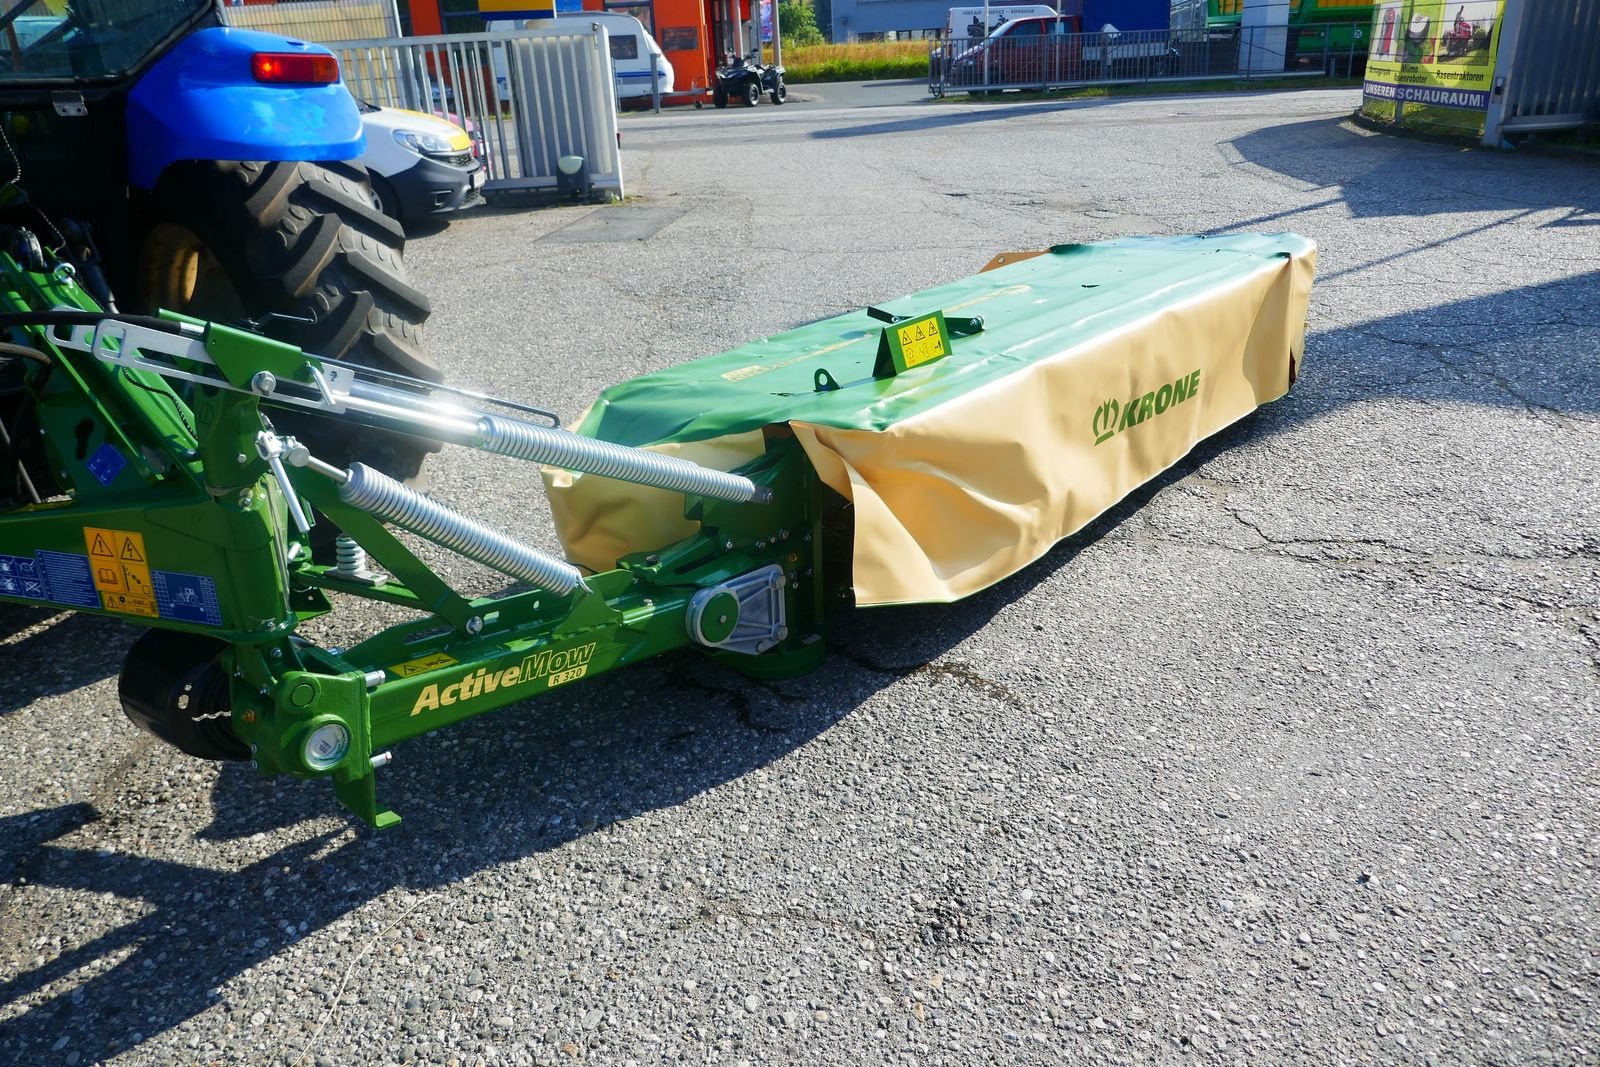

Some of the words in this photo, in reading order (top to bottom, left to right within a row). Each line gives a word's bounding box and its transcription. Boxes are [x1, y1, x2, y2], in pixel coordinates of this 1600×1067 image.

[1435, 70, 1484, 81] Rasentraktoren
[1365, 83, 1396, 98] UNSEREN
[1397, 88, 1485, 107] SCHAURAUM!
[1118, 368, 1201, 433] KRONE
[410, 642, 597, 716] ActiveMow
[553, 675, 561, 685] R
[563, 667, 582, 682] 320
